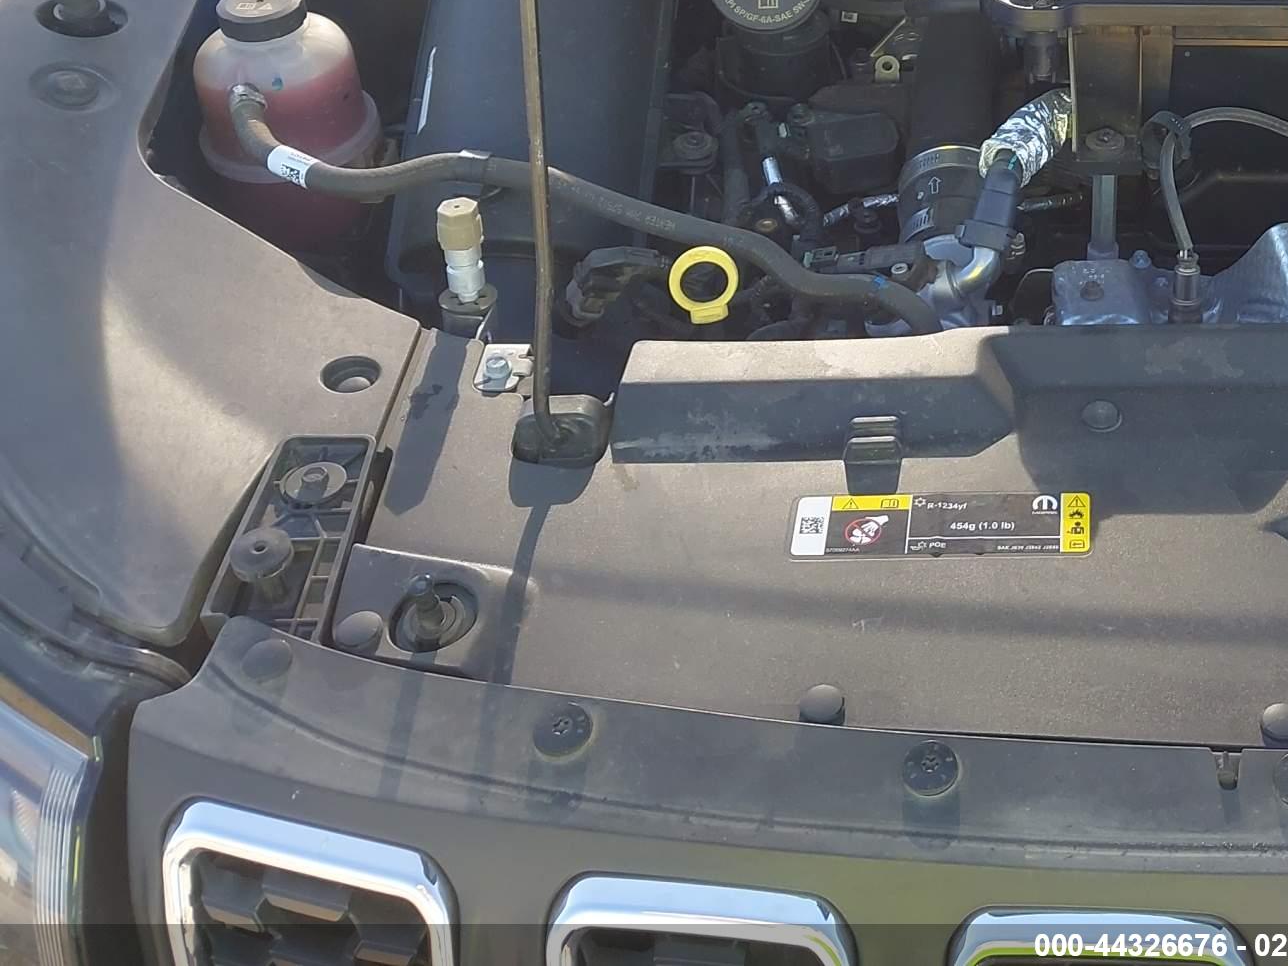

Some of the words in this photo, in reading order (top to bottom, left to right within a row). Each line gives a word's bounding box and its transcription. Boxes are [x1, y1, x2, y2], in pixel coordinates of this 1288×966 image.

[927, 501, 967, 512] R-1234yf
[950, 521, 975, 532] 454g
[978, 520, 998, 532] (1.0
[1001, 520, 1015, 532] lb)
[929, 541, 947, 549] POE
